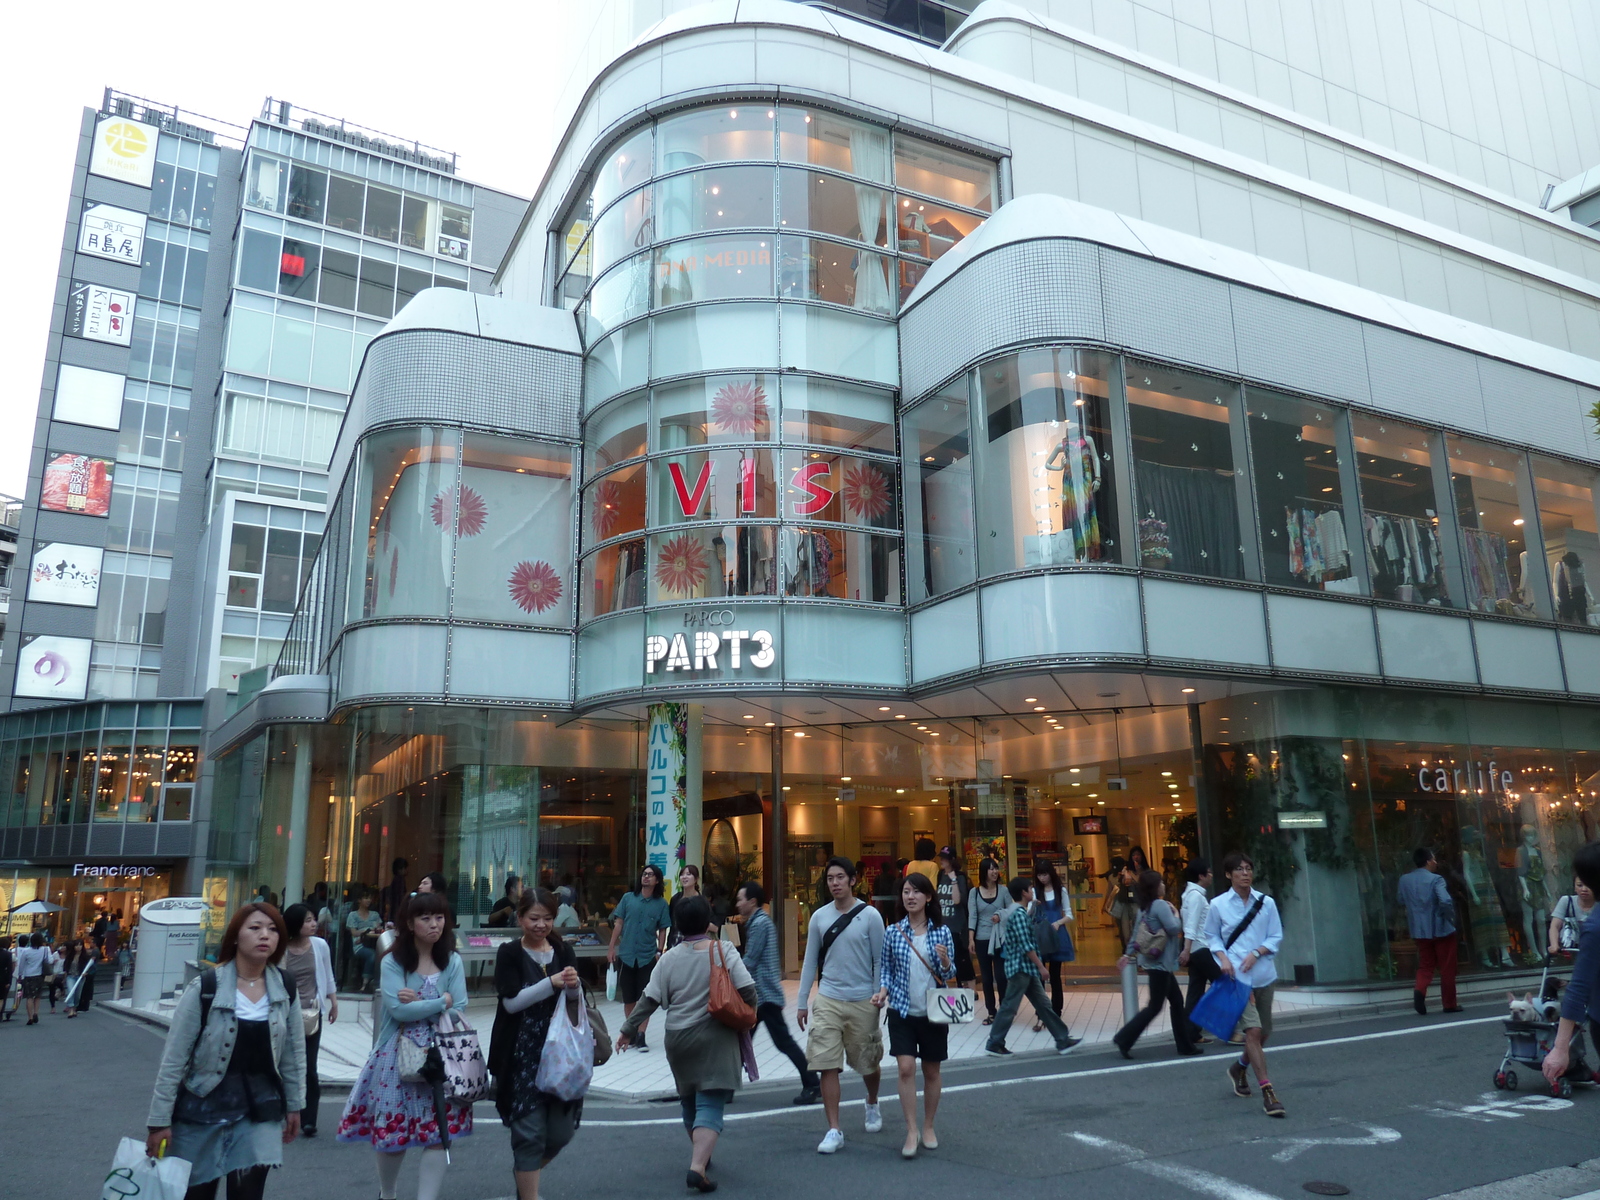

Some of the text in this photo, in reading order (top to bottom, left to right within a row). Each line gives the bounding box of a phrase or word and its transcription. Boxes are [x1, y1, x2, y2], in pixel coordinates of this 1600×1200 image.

[88, 233, 134, 258] 月島屋
[705, 249, 771, 269] MEDIA
[89, 289, 107, 334] Kirara
[68, 455, 89, 495] 食べ放題
[667, 457, 835, 518] VIS
[683, 609, 735, 627] PARCO
[646, 629, 776, 674] PART3
[1418, 760, 1514, 793] carlife
[73, 863, 156, 877] Francfranc
